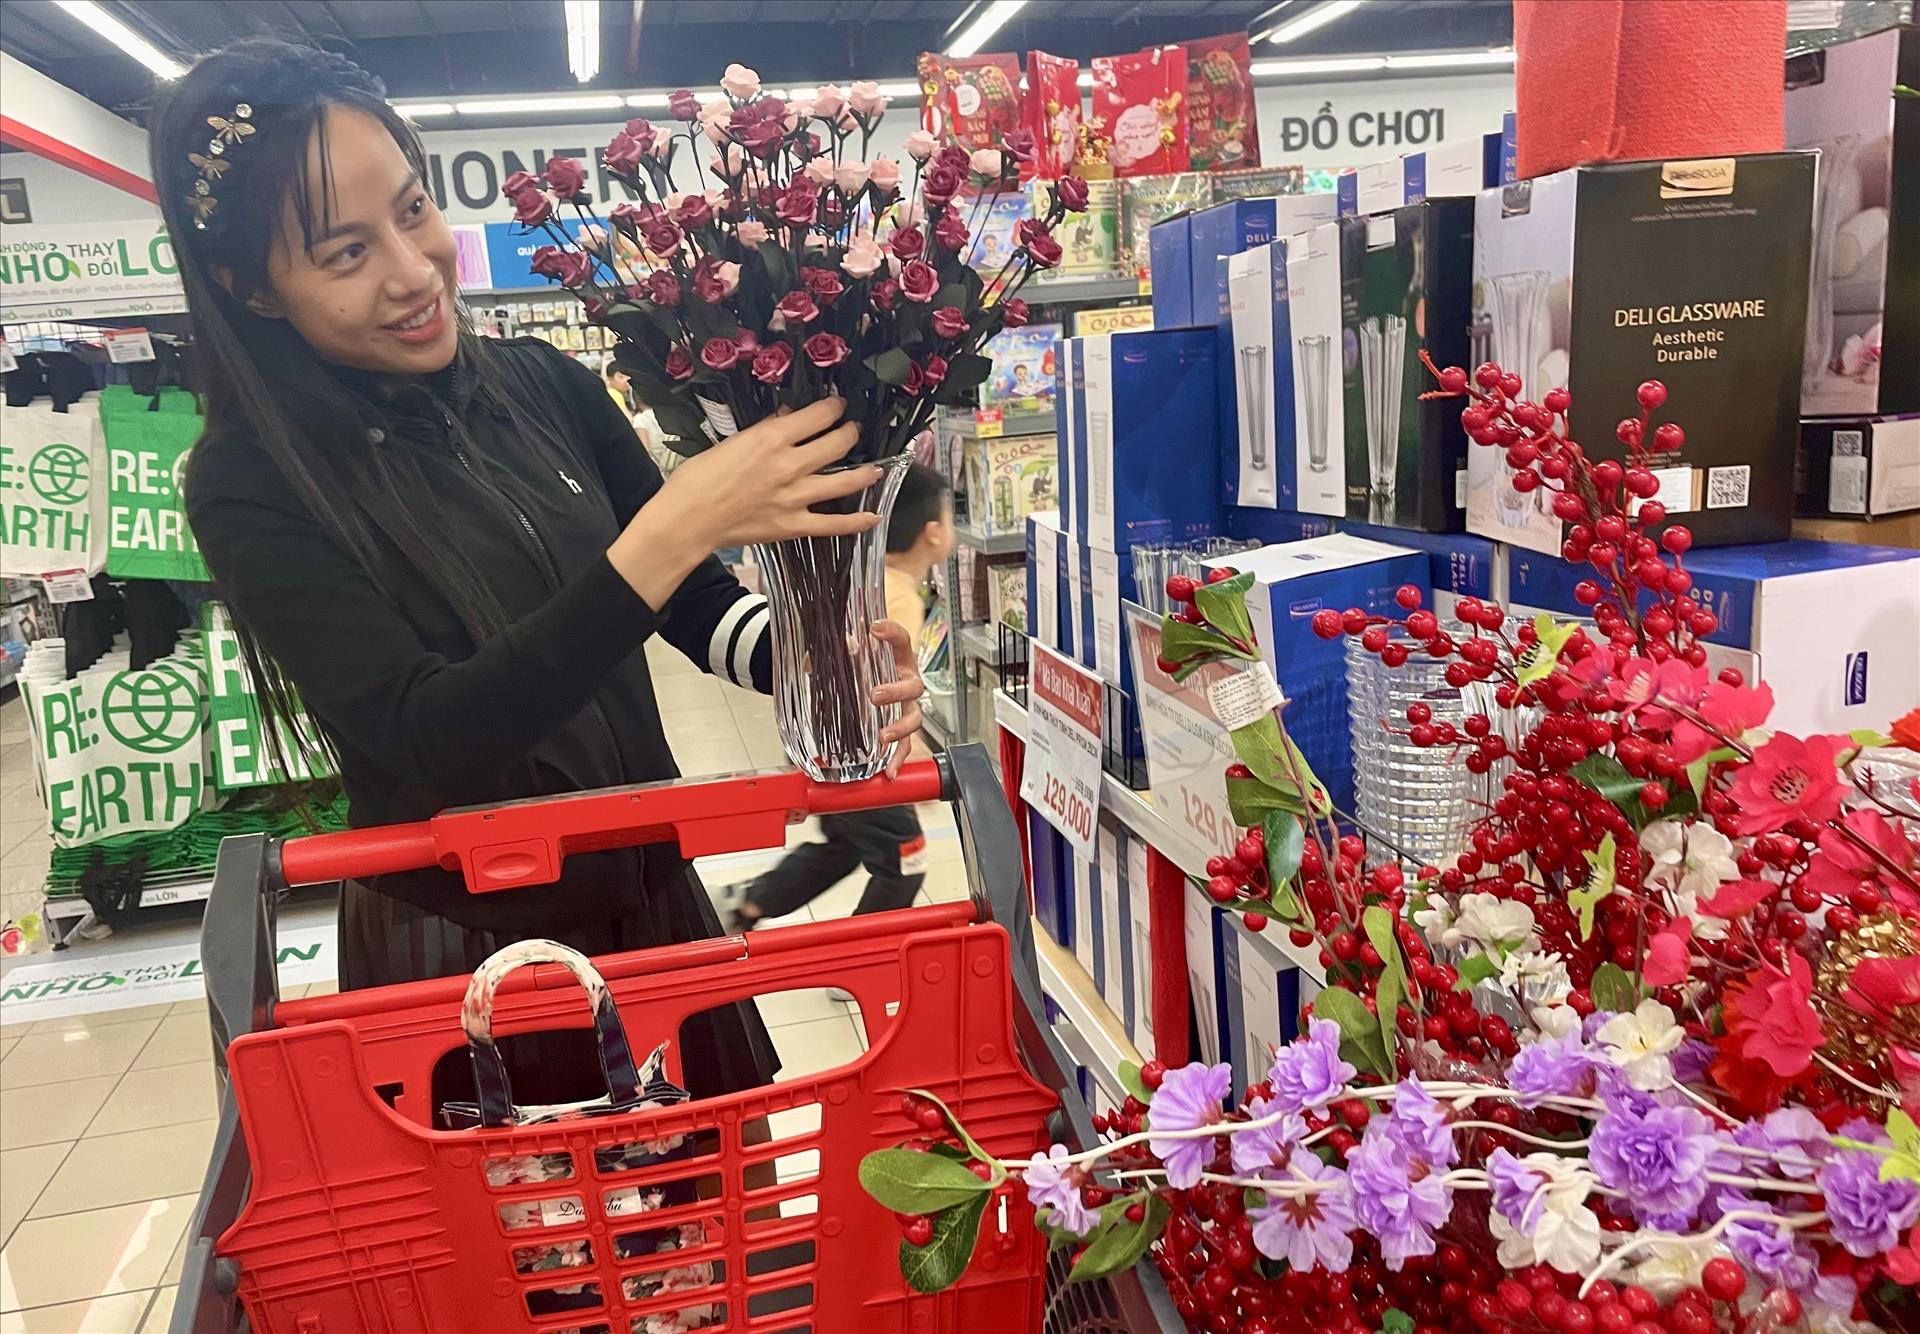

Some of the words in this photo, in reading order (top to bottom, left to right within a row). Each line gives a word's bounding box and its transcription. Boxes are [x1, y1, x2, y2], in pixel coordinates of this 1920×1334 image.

[1349, 107, 1445, 148] CHƠI
[429, 143, 679, 211] IONERY
[67, 242, 114, 258] THAY
[1246, 233, 1270, 243] DELI
[1615, 308, 1653, 327] DELI
[1656, 300, 1765, 324] GLASSWARE
[1652, 328, 1725, 346] Aesthetic
[1657, 346, 1718, 363] Durable
[111, 449, 169, 495] RE:
[43, 685, 99, 759] RE:
[50, 762, 202, 840] EARTH
[1043, 770, 1091, 842] 129,000
[1180, 784, 1236, 857] 129,0
[124, 961, 186, 977] THAY
